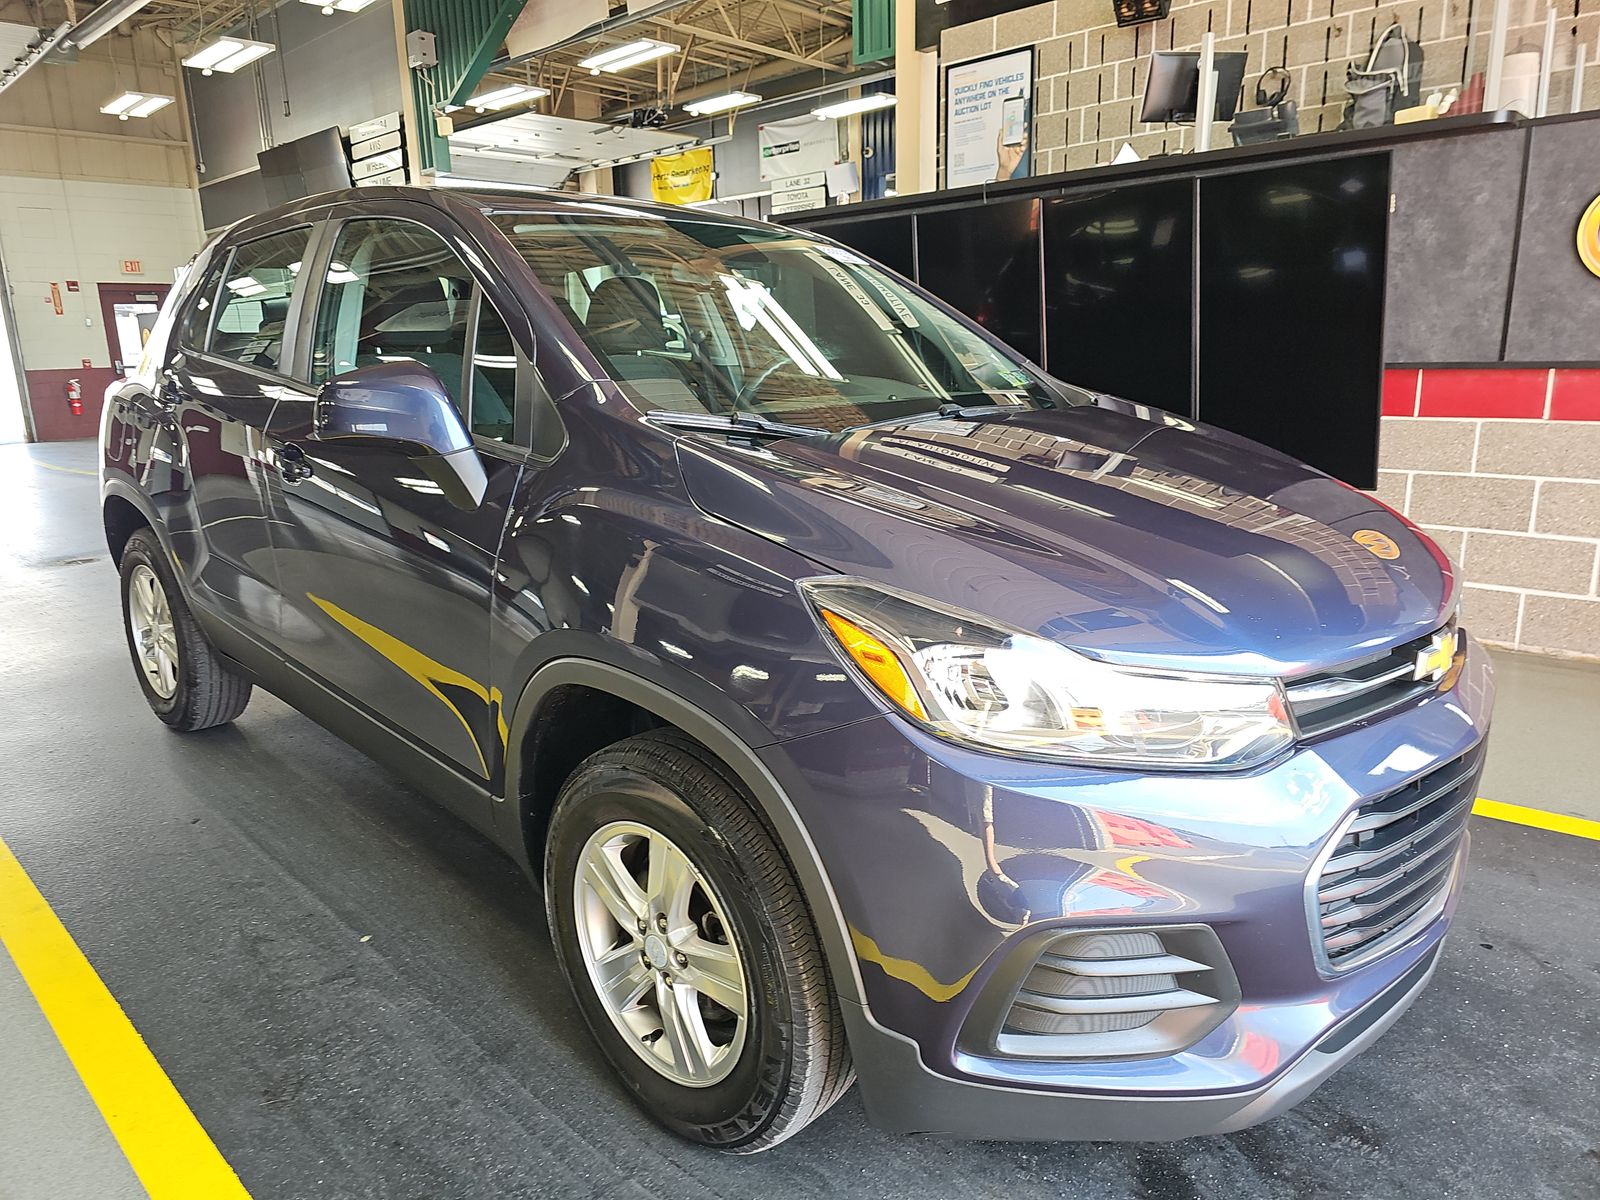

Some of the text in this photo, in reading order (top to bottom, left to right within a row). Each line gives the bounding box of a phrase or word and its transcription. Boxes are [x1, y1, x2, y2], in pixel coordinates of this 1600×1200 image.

[954, 72, 1024, 96] QUICKLY FIND VEHICLES
[954, 86, 1010, 105] ANYWHERE ON THE
[954, 101, 993, 116] AUCTION LOT
[785, 179, 801, 188] LANE
[787, 192, 809, 201] TOYOTA
[124, 260, 141, 273] EXIT
[699, 1054, 786, 1144] NEXEN
